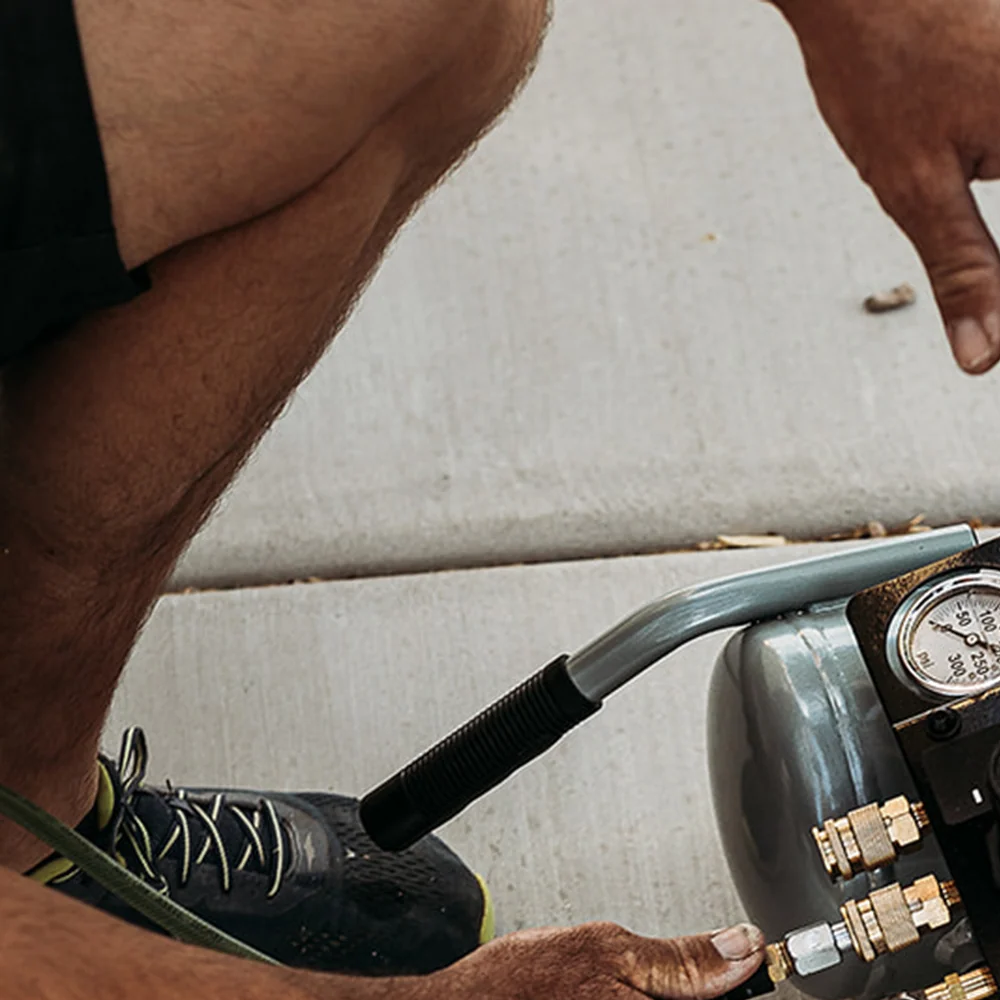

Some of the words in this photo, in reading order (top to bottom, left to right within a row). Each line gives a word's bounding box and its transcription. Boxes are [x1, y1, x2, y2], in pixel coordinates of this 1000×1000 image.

[956, 611, 972, 627] 50
[979, 610, 998, 633] 100
[947, 653, 967, 678] 300
[970, 652, 990, 676] 250
